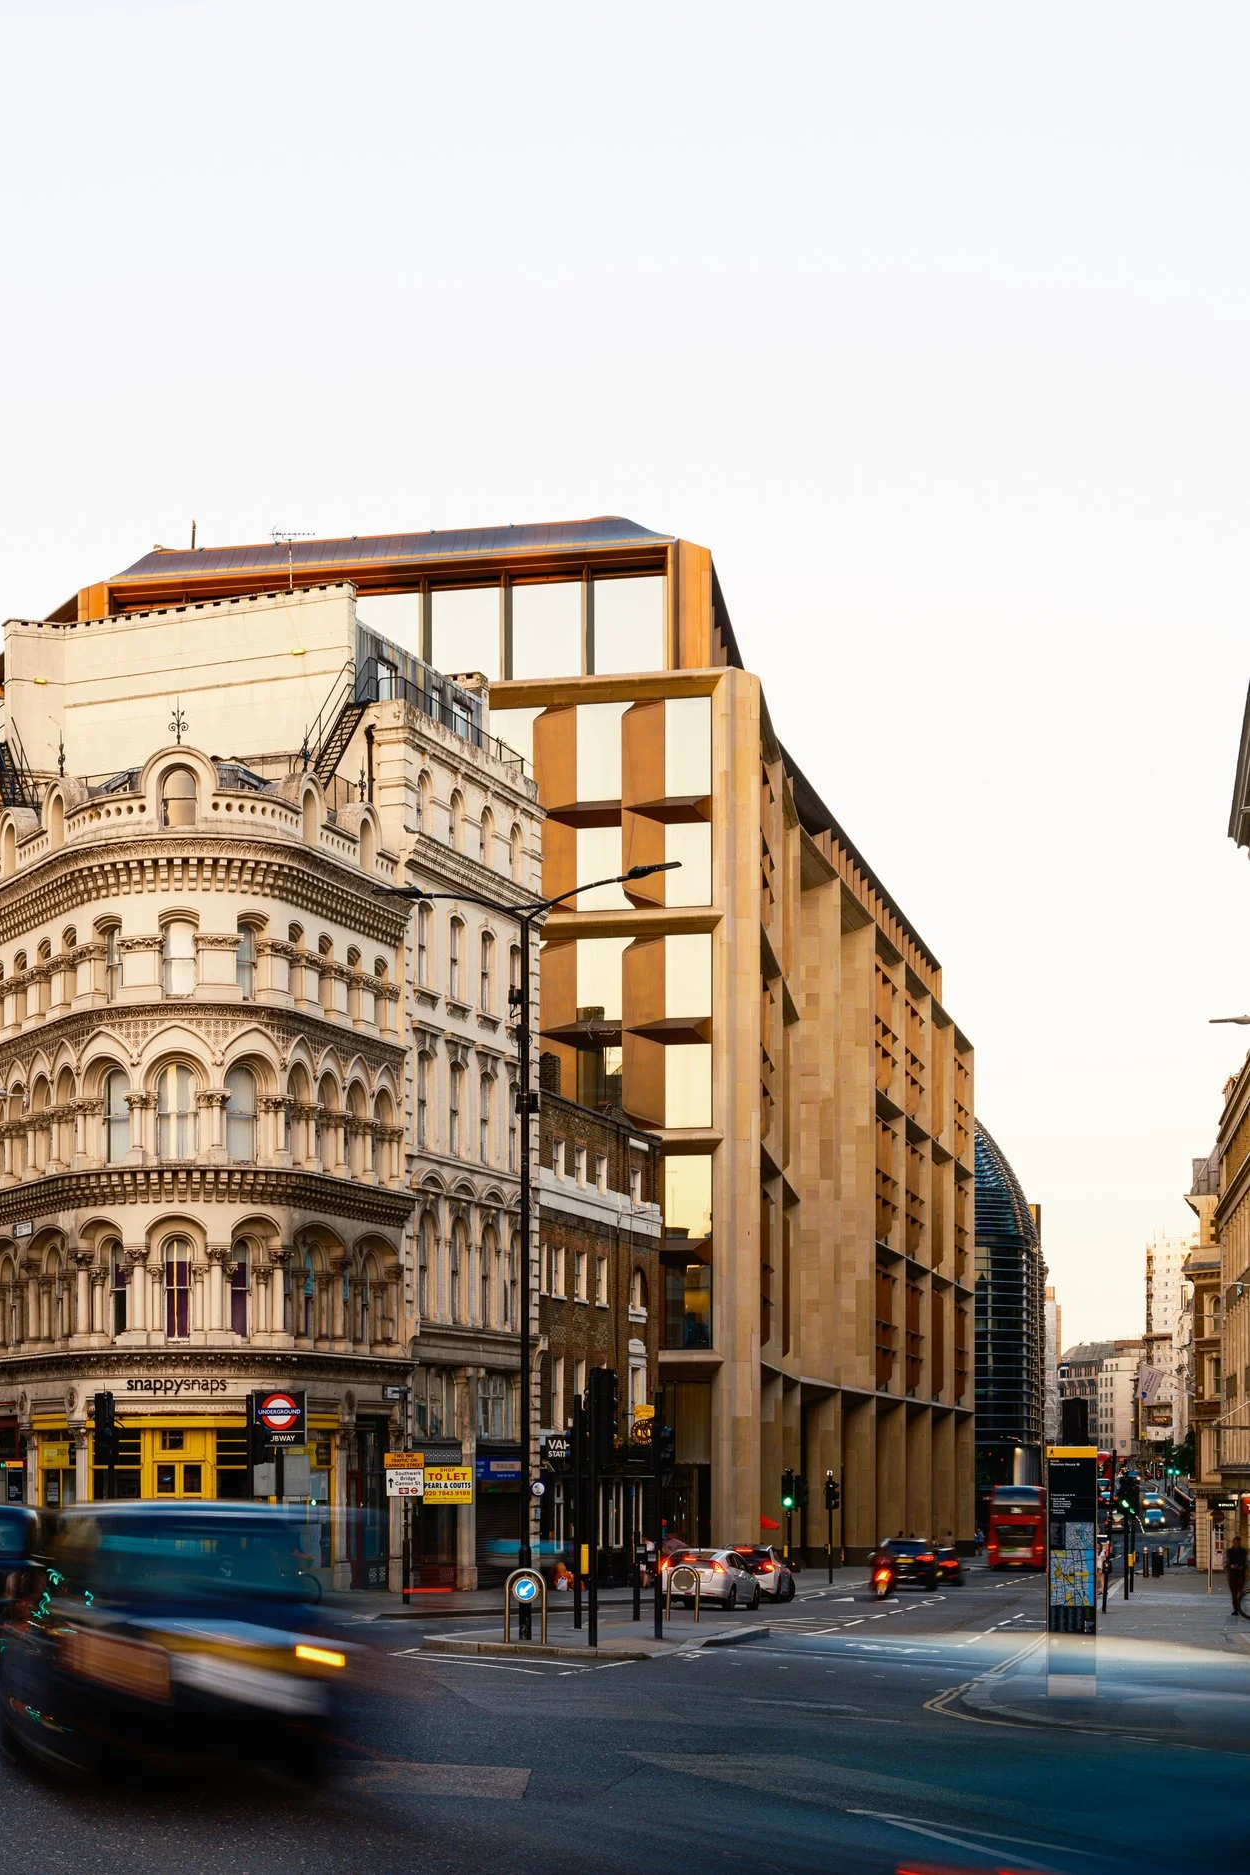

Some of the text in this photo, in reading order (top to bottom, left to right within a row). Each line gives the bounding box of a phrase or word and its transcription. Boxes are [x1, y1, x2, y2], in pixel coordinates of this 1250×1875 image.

[126, 1378, 227, 1395] snappysnaps
[427, 1472, 443, 1481] TO
[446, 1472, 468, 1481] LET
